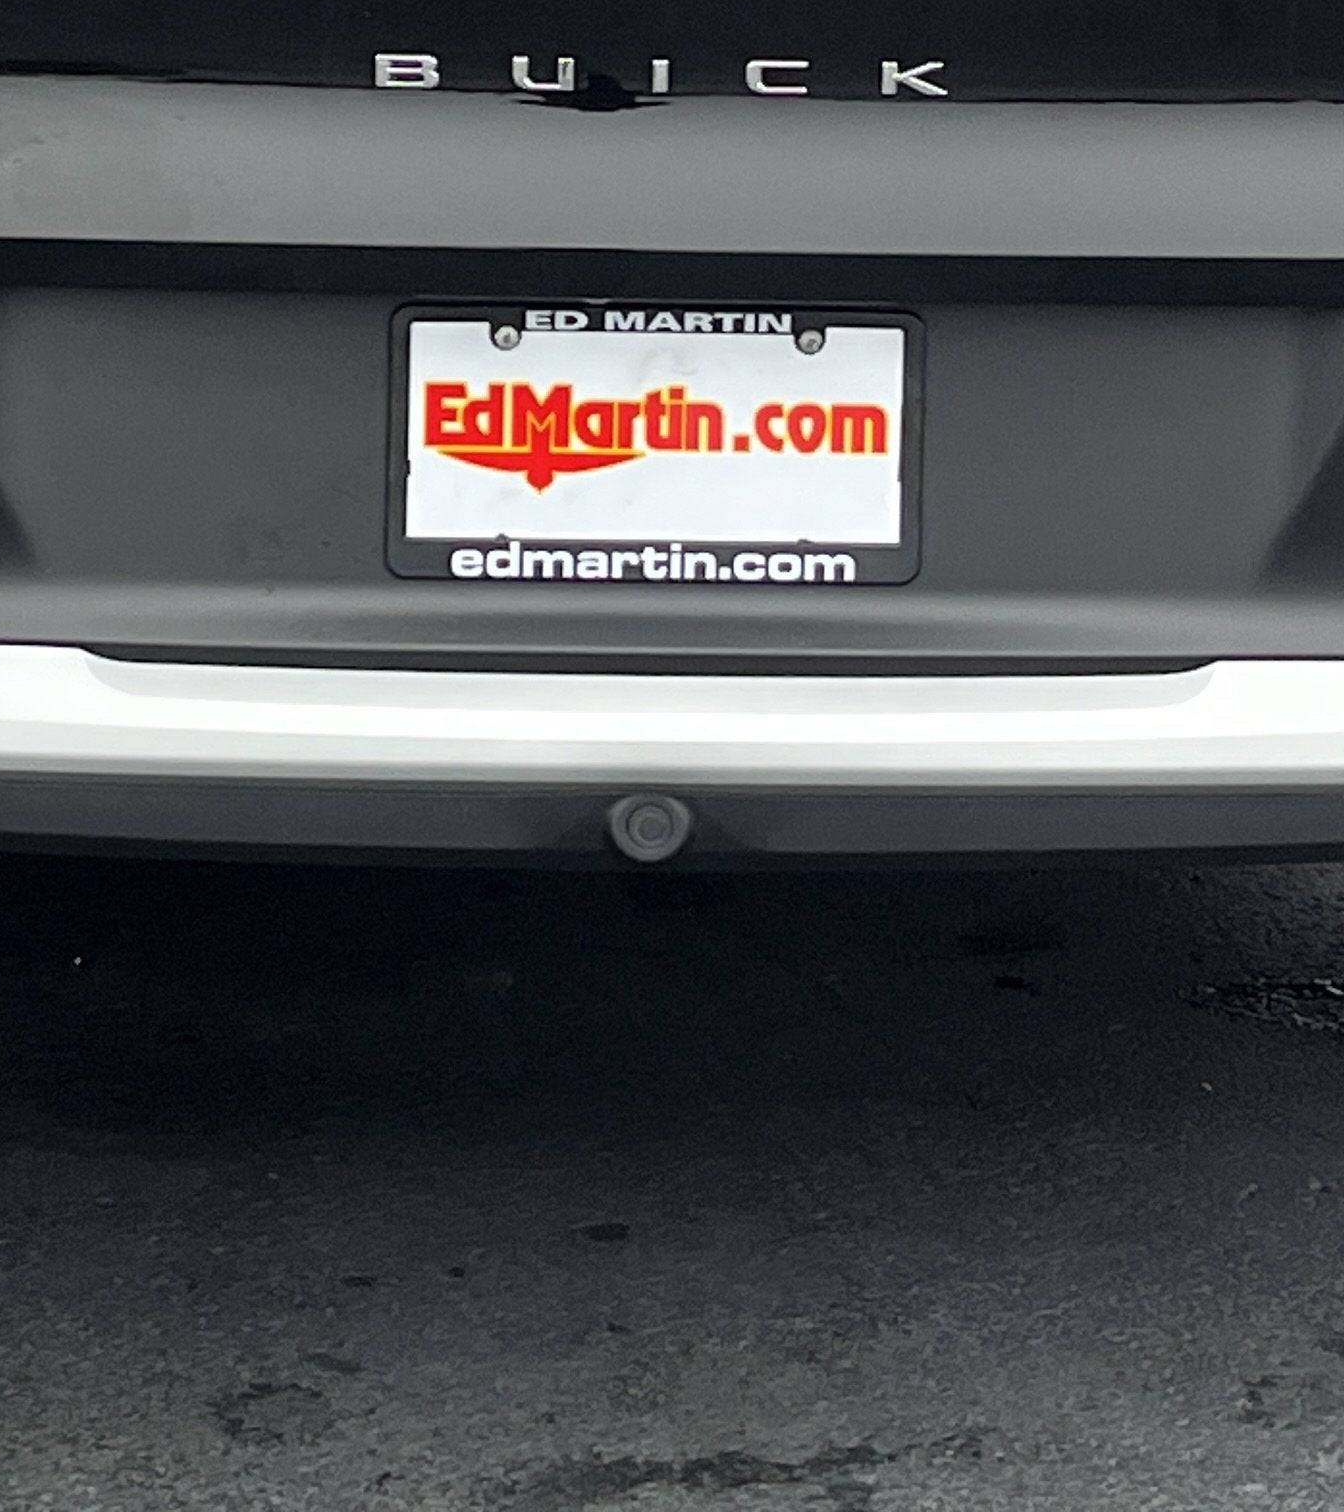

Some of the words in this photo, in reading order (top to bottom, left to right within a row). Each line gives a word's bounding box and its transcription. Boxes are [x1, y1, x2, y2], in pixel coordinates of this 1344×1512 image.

[374, 53, 948, 96] BUICK
[524, 309, 590, 332] ED
[604, 310, 792, 335] MARTIN
[422, 381, 888, 456] EdMartin.com
[450, 541, 857, 583] edmartin.com
